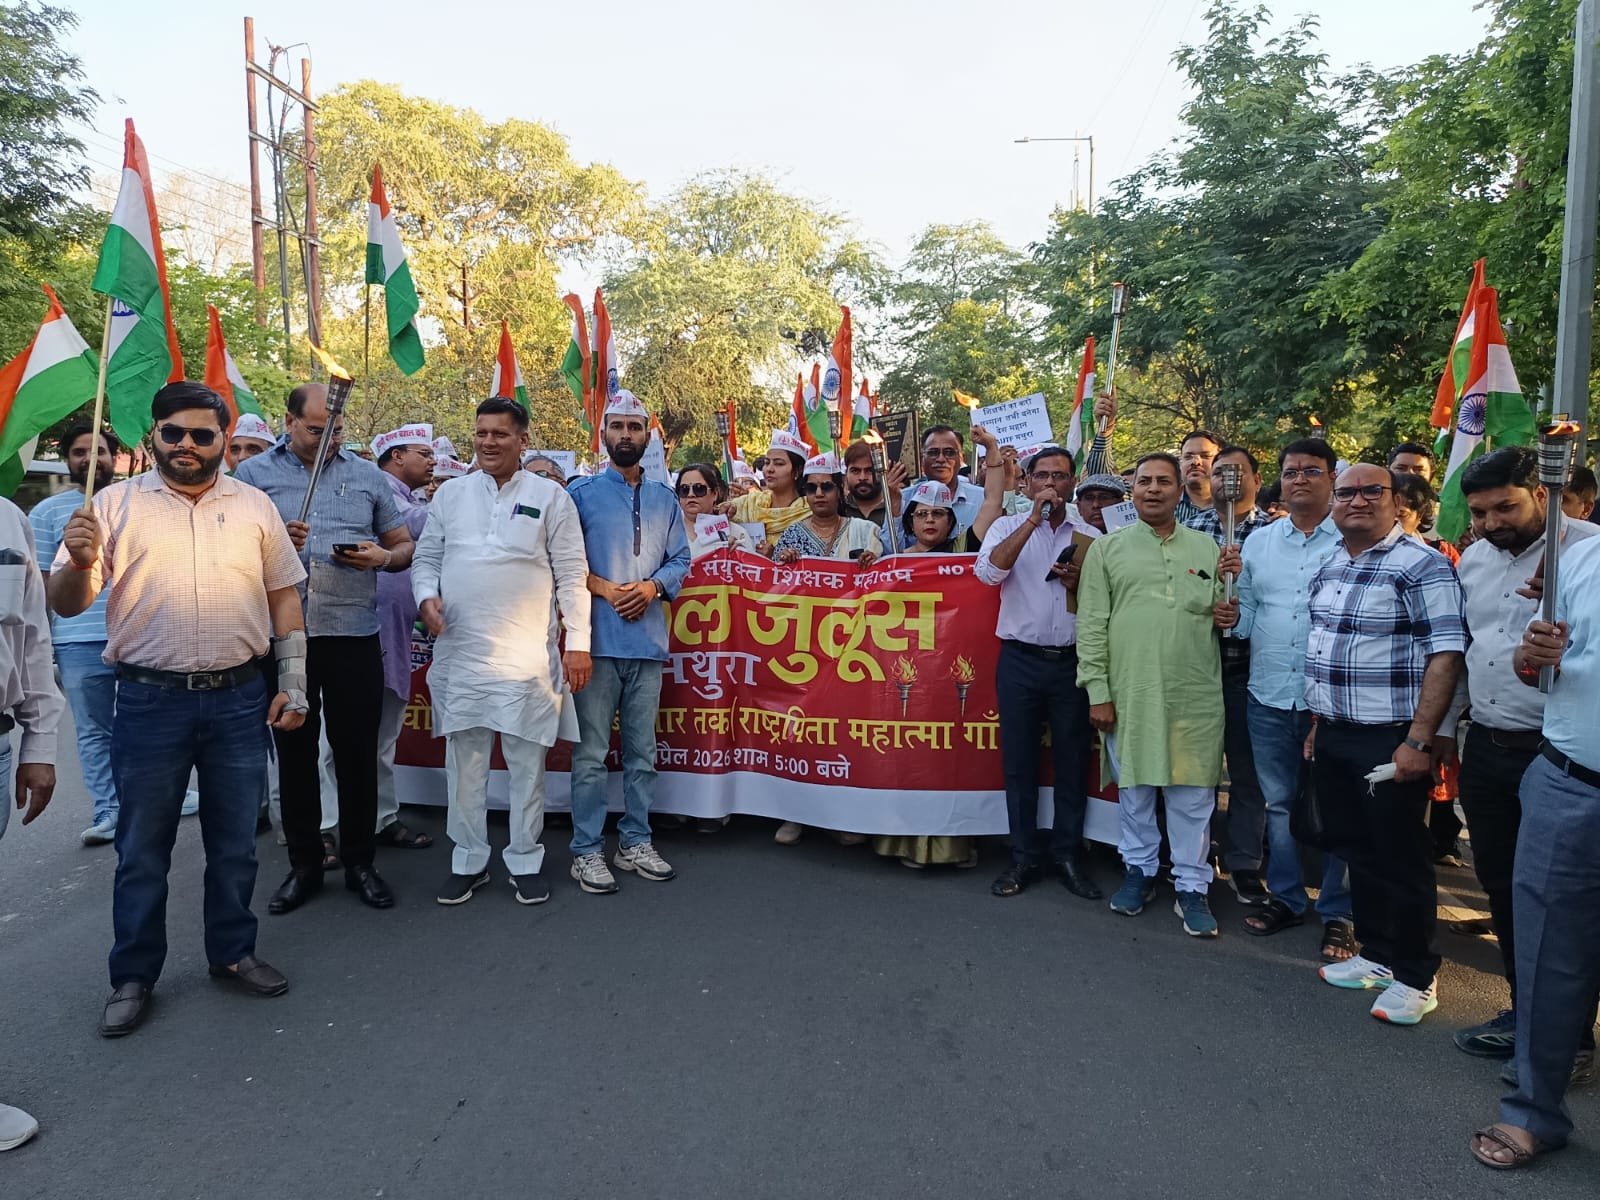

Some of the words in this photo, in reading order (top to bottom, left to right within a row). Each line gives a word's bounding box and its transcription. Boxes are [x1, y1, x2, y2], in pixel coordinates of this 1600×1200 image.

[702, 554, 763, 586] संयुक्त
[771, 561, 847, 590] शिक्षक
[937, 565, 965, 576] NO
[742, 589, 943, 685] जुलूस
[848, 718, 955, 754] महात्मा
[654, 740, 689, 766] प्रैल
[692, 749, 731, 768] 2026
[733, 748, 769, 768] शाम
[775, 756, 809, 776] 5:00
[815, 754, 851, 779] बजे
